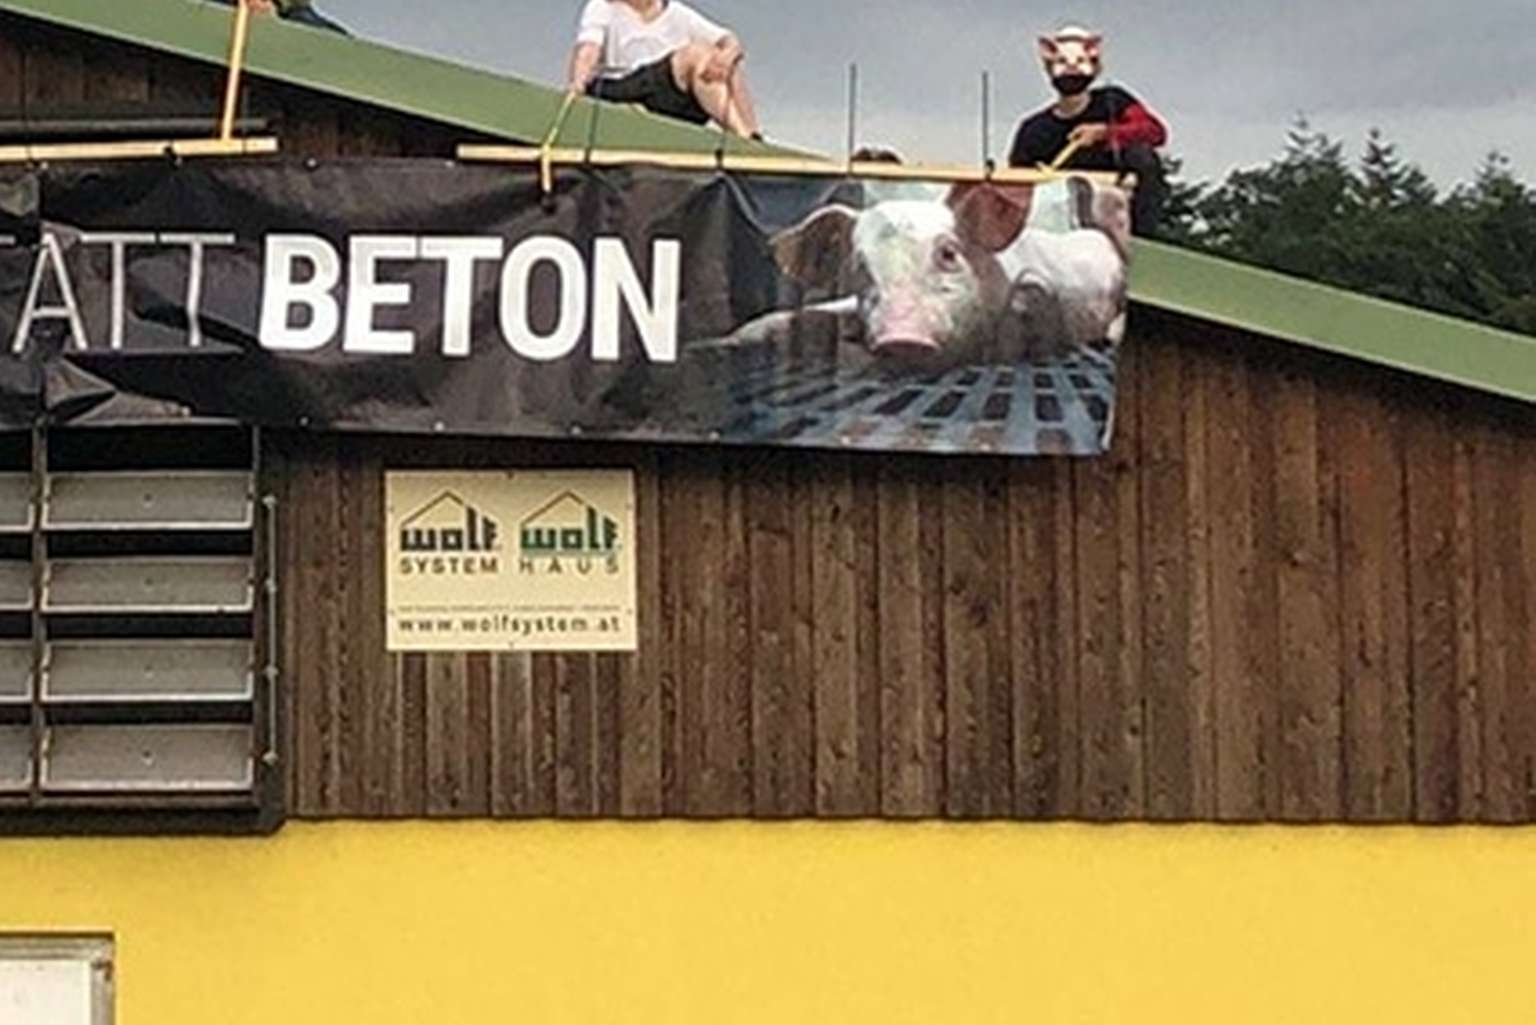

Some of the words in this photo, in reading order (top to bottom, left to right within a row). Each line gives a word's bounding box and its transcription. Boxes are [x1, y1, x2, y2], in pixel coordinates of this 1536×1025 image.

[259, 233, 681, 362] BETON
[400, 505, 498, 551] wolf
[520, 505, 619, 550] wolf
[400, 557, 498, 574] SYSTEM
[519, 557, 619, 574] HAUS
[398, 616, 621, 636] www.wolfsystem.at
